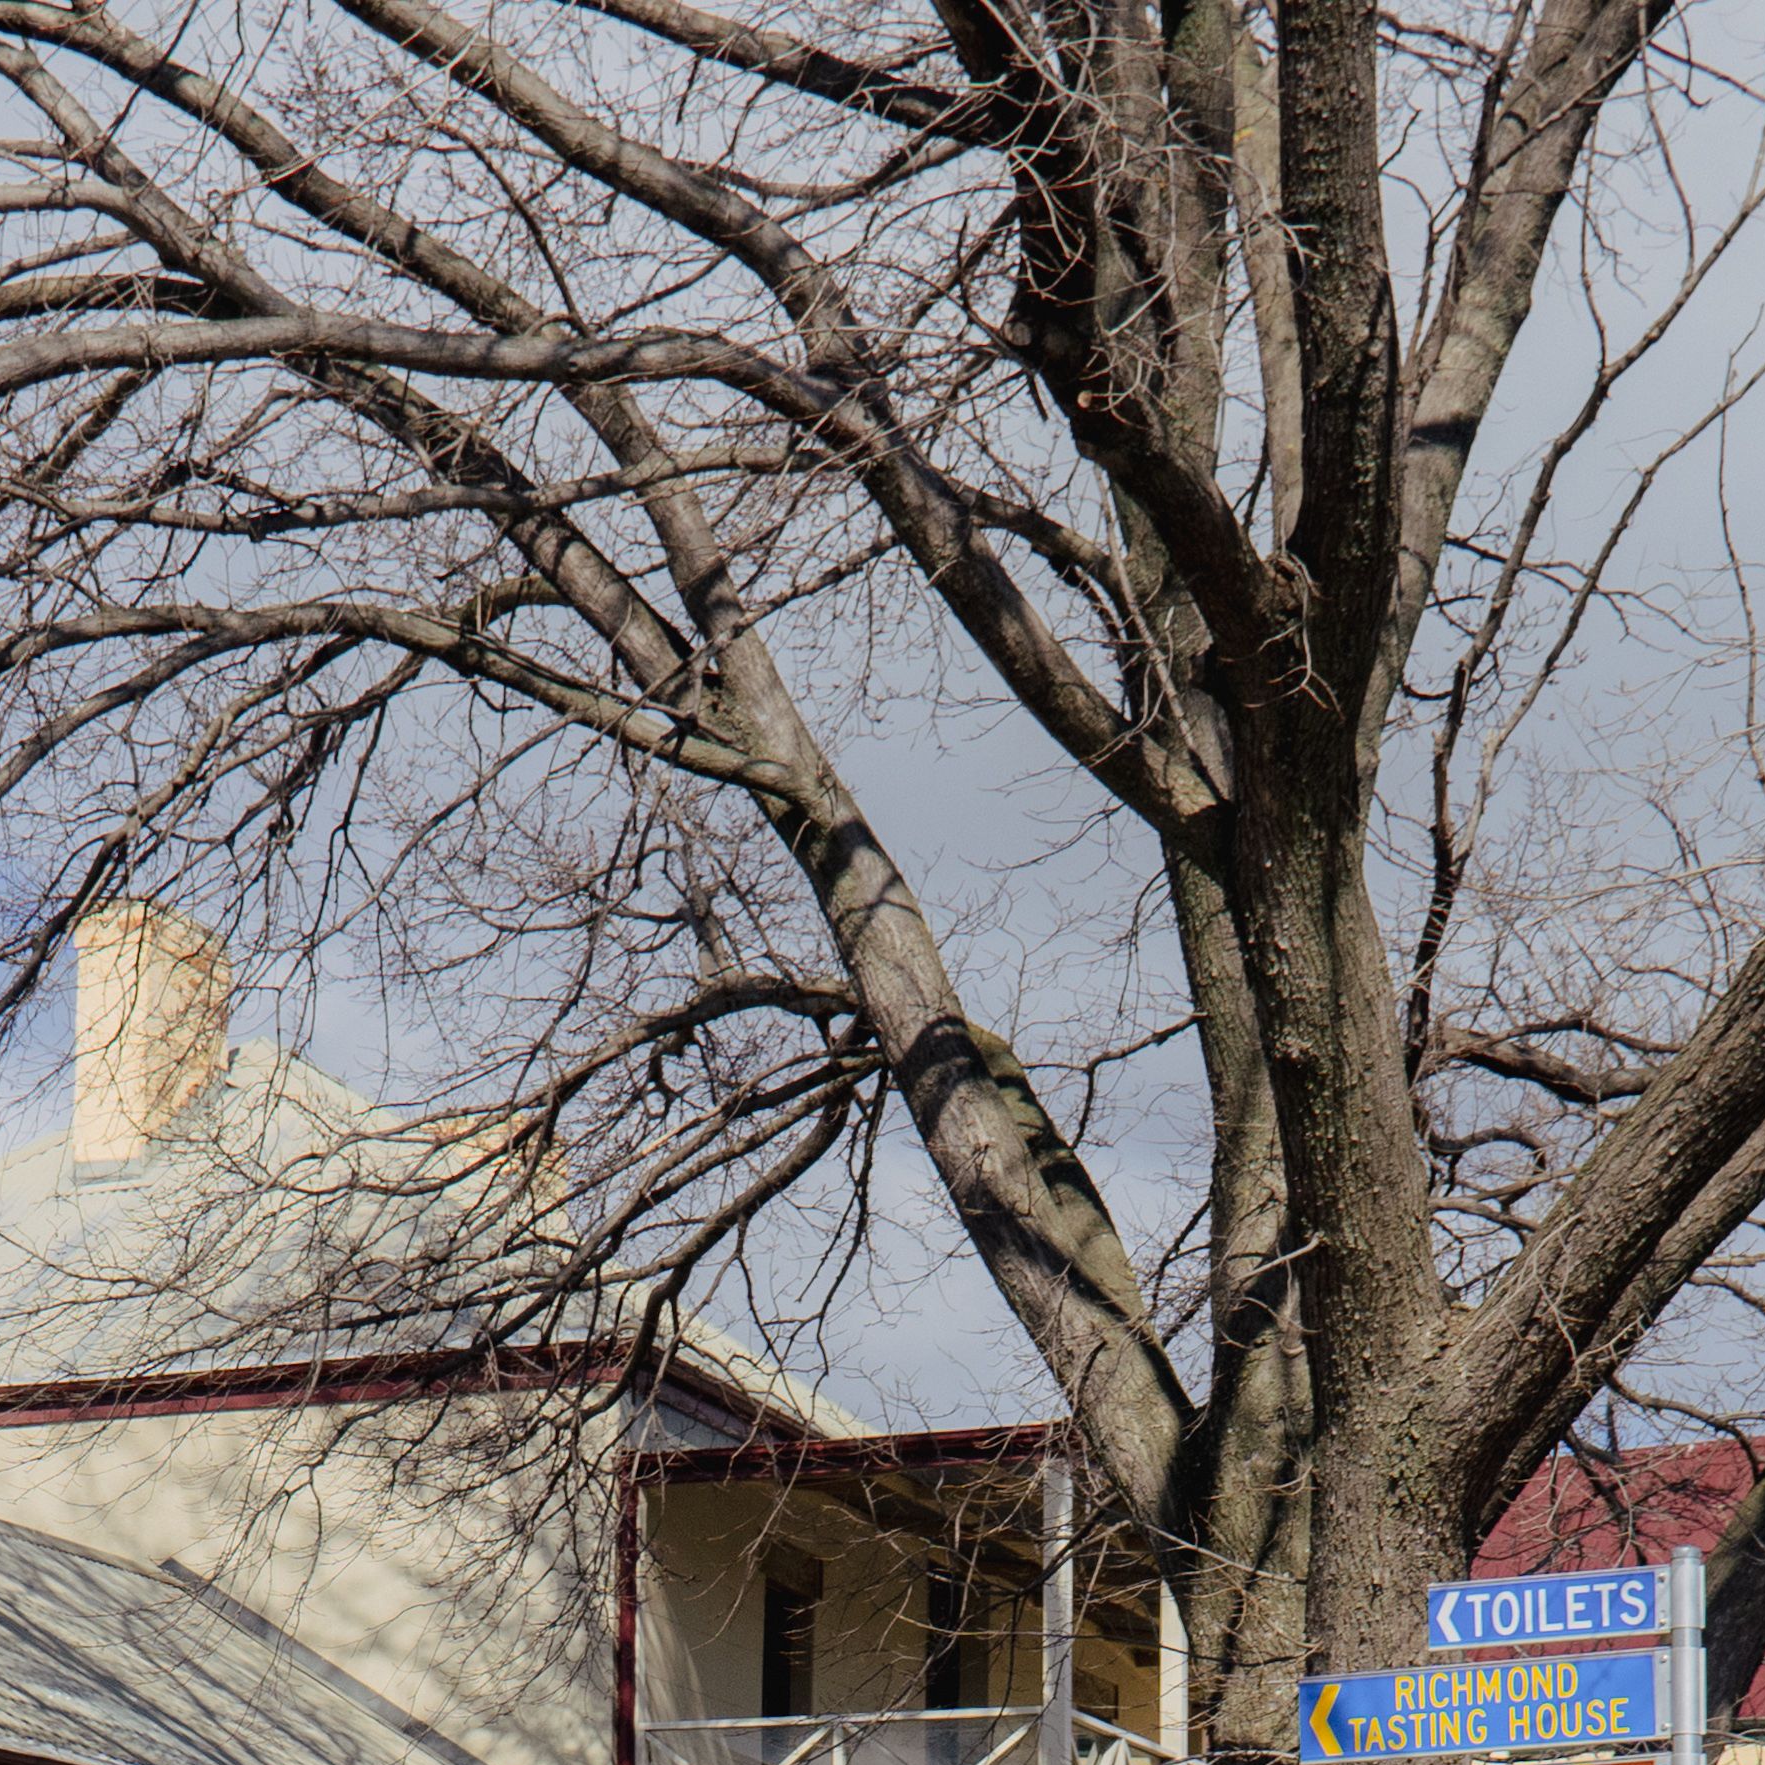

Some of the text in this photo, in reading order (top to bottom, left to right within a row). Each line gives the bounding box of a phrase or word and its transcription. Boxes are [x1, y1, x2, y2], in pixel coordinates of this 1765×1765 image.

[1465, 1579, 1648, 1638] TOILETS
[1394, 1662, 1579, 1711] RICHMOND
[1348, 1697, 1630, 1753] TASTING HOUSE
